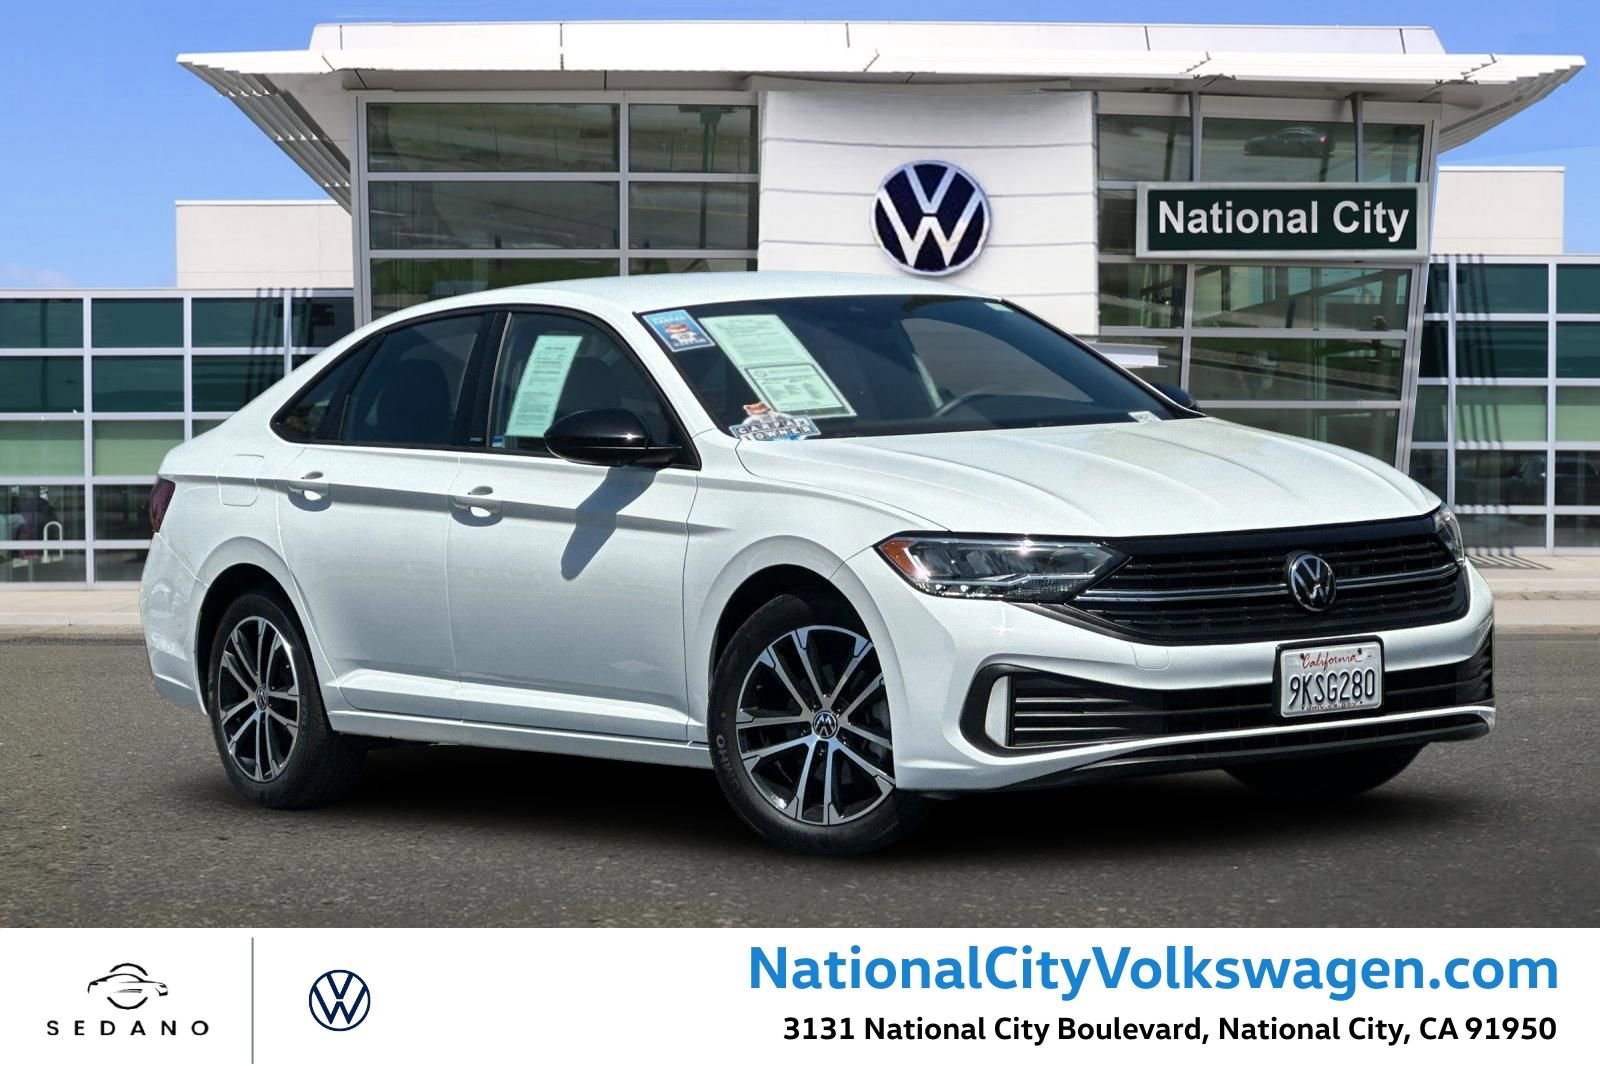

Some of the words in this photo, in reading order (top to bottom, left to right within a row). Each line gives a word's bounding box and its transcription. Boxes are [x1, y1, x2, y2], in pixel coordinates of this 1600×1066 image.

[871, 160, 991, 276] VW
[1159, 200, 1318, 234] National
[1332, 200, 1410, 242] City
[1302, 651, 1357, 671] California
[1289, 669, 1375, 708] 9KSG280
